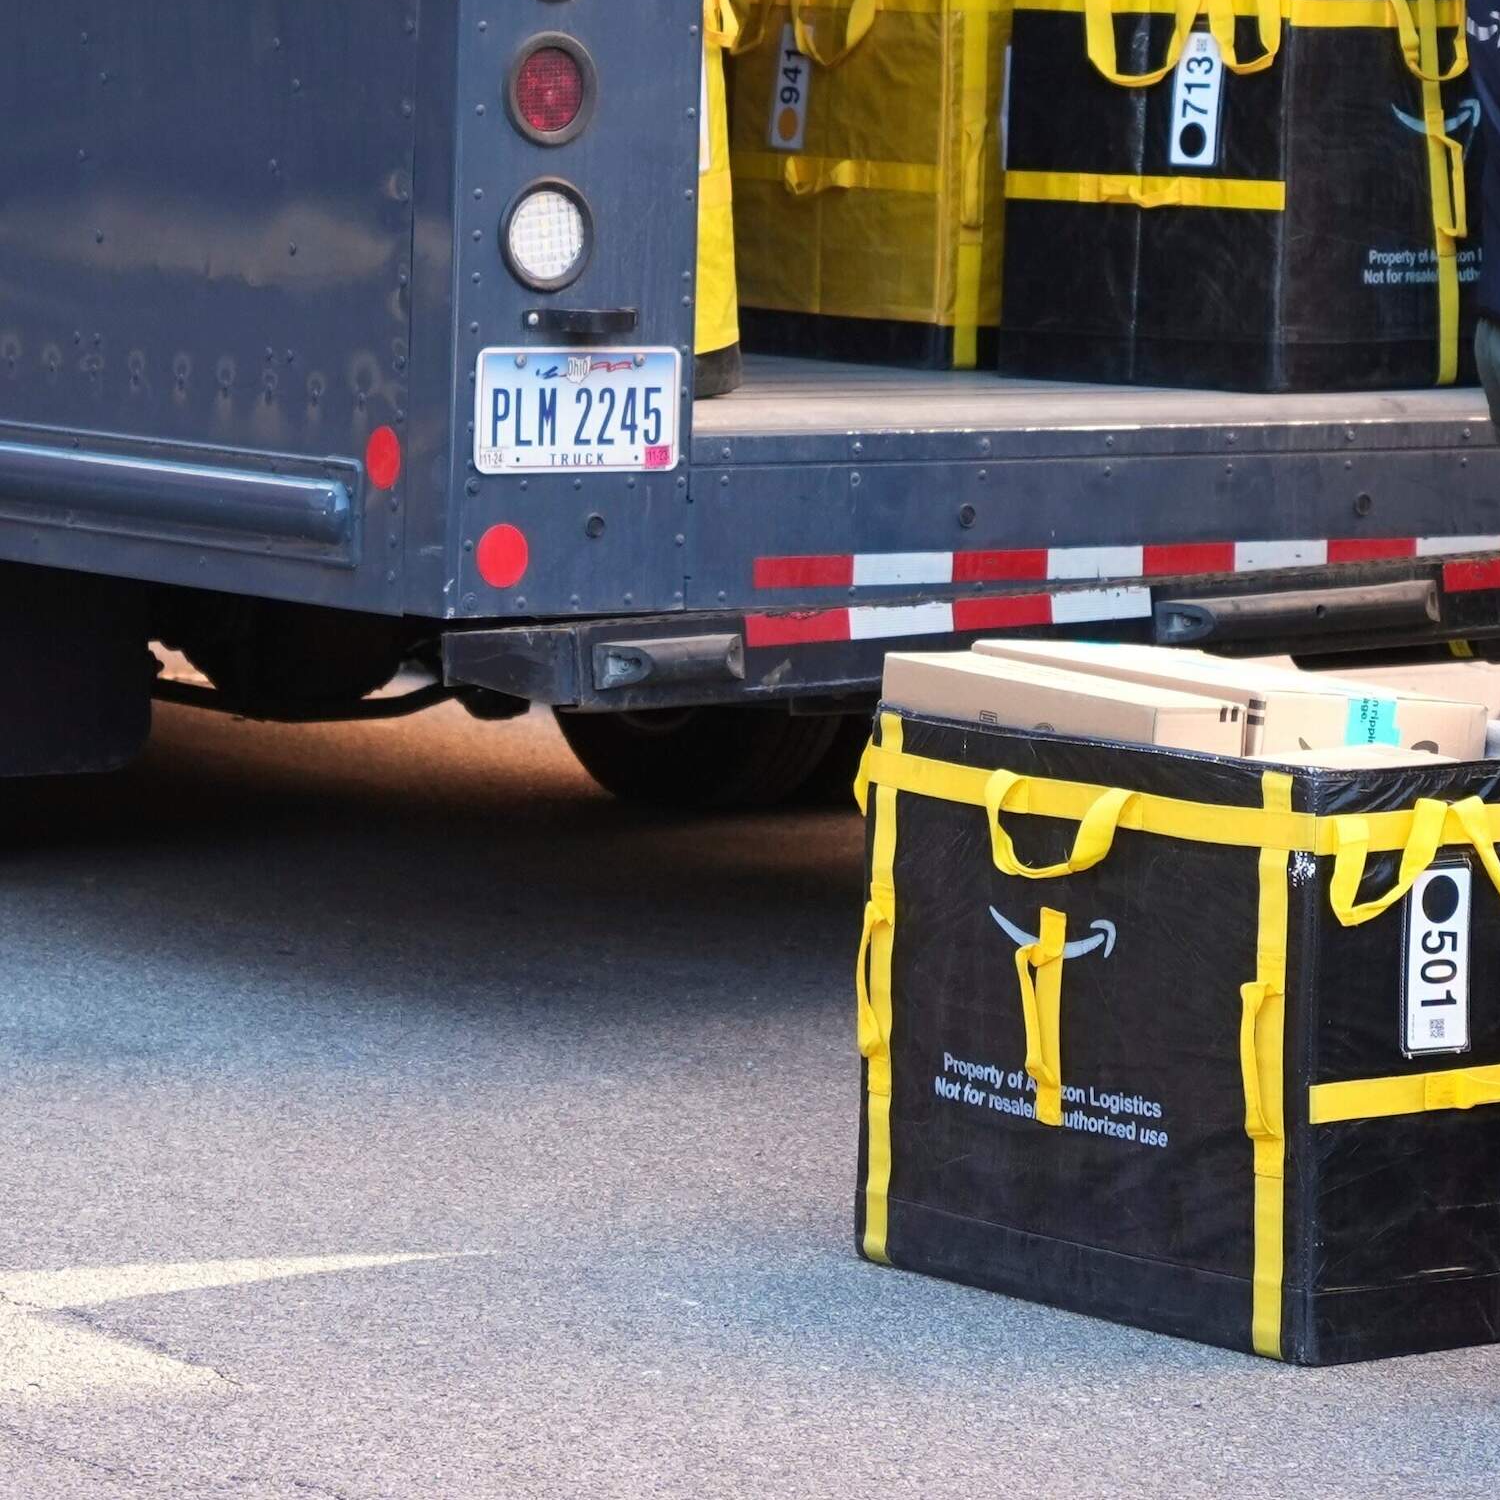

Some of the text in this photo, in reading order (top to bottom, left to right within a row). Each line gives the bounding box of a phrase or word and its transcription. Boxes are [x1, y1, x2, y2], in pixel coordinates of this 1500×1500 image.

[780, 49, 807, 105] 941
[1182, 56, 1213, 118] 713
[1363, 268, 1385, 285] Not
[1386, 268, 1403, 284] for
[1368, 249, 1416, 268] Property
[568, 359, 589, 377] Ohio
[491, 387, 663, 447] PLM 2245
[551, 453, 605, 466] TRUCK
[1420, 929, 1459, 1008] 501
[935, 1075, 962, 1101] Not
[963, 1082, 987, 1107] for
[1139, 1127, 1169, 1149] use
[943, 1051, 1163, 1119] Property of Azon Logistics
